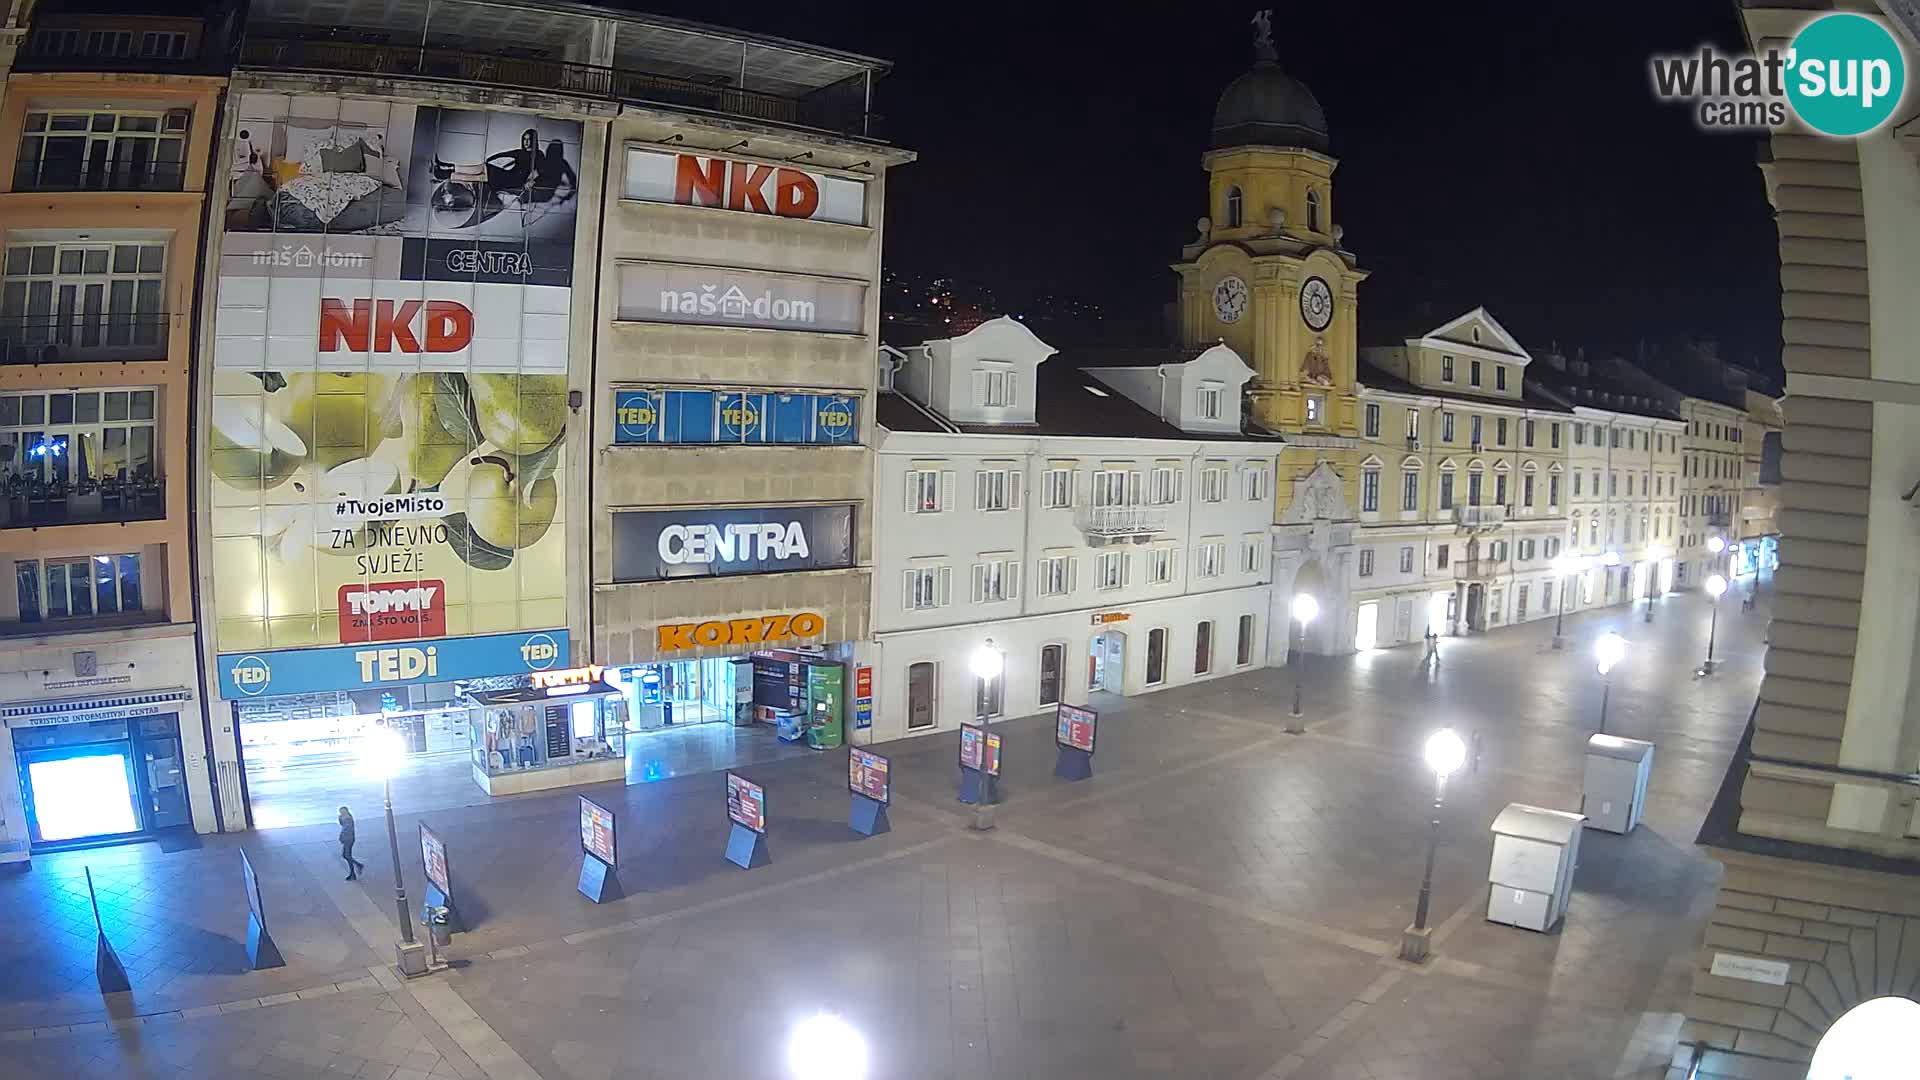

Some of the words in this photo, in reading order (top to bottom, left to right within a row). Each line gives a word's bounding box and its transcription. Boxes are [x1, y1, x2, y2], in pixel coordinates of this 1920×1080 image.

[674, 153, 820, 220] NKD
[252, 245, 291, 267] naš
[316, 246, 364, 269] dom
[445, 249, 534, 275] CENTRA
[659, 284, 716, 317] naš
[752, 290, 816, 323] dom
[317, 296, 476, 354] NKD
[617, 408, 657, 425] TEDi
[722, 408, 759, 426] TEDi
[819, 410, 852, 427] TEDi
[335, 498, 445, 517] #TvojeMisto
[331, 528, 356, 550] ZA
[366, 524, 449, 548] DNEVNO
[657, 520, 810, 564] CENTRA
[357, 547, 425, 576] SVJEŽE
[346, 587, 437, 615] TOMMY
[377, 614, 397, 625] ŠTO
[657, 612, 826, 652] KORZO
[354, 646, 438, 684] TEDi
[521, 642, 559, 662] TEDi
[231, 664, 271, 687] TEDi
[531, 664, 604, 689] TOMMY
